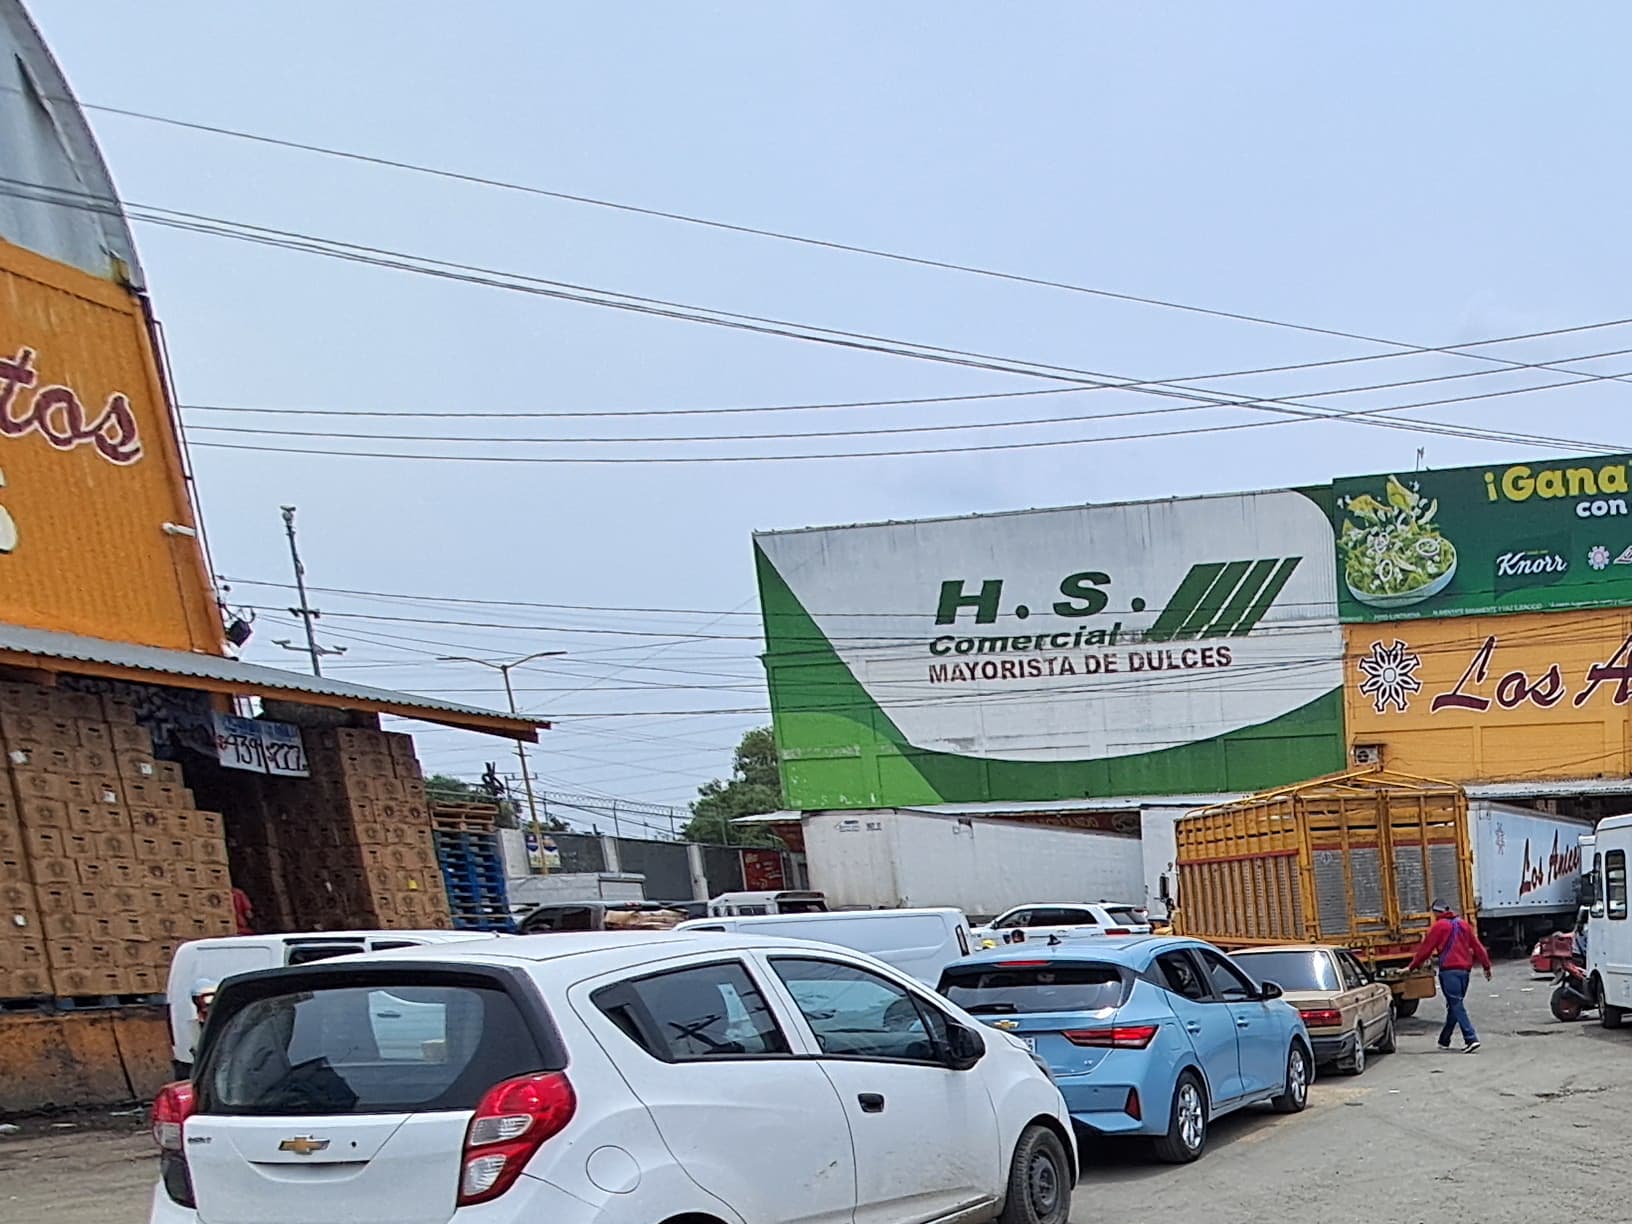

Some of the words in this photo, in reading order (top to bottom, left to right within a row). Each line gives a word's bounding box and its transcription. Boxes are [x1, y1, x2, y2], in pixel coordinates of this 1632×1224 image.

[1575, 498, 1628, 518] con
[1496, 550, 1568, 577] Knorr
[929, 621, 1122, 656] Comercial
[929, 655, 1075, 684] MAYORISTA
[1084, 652, 1119, 674] DE
[1128, 645, 1233, 673] DULCES
[1430, 634, 1566, 715] Los
